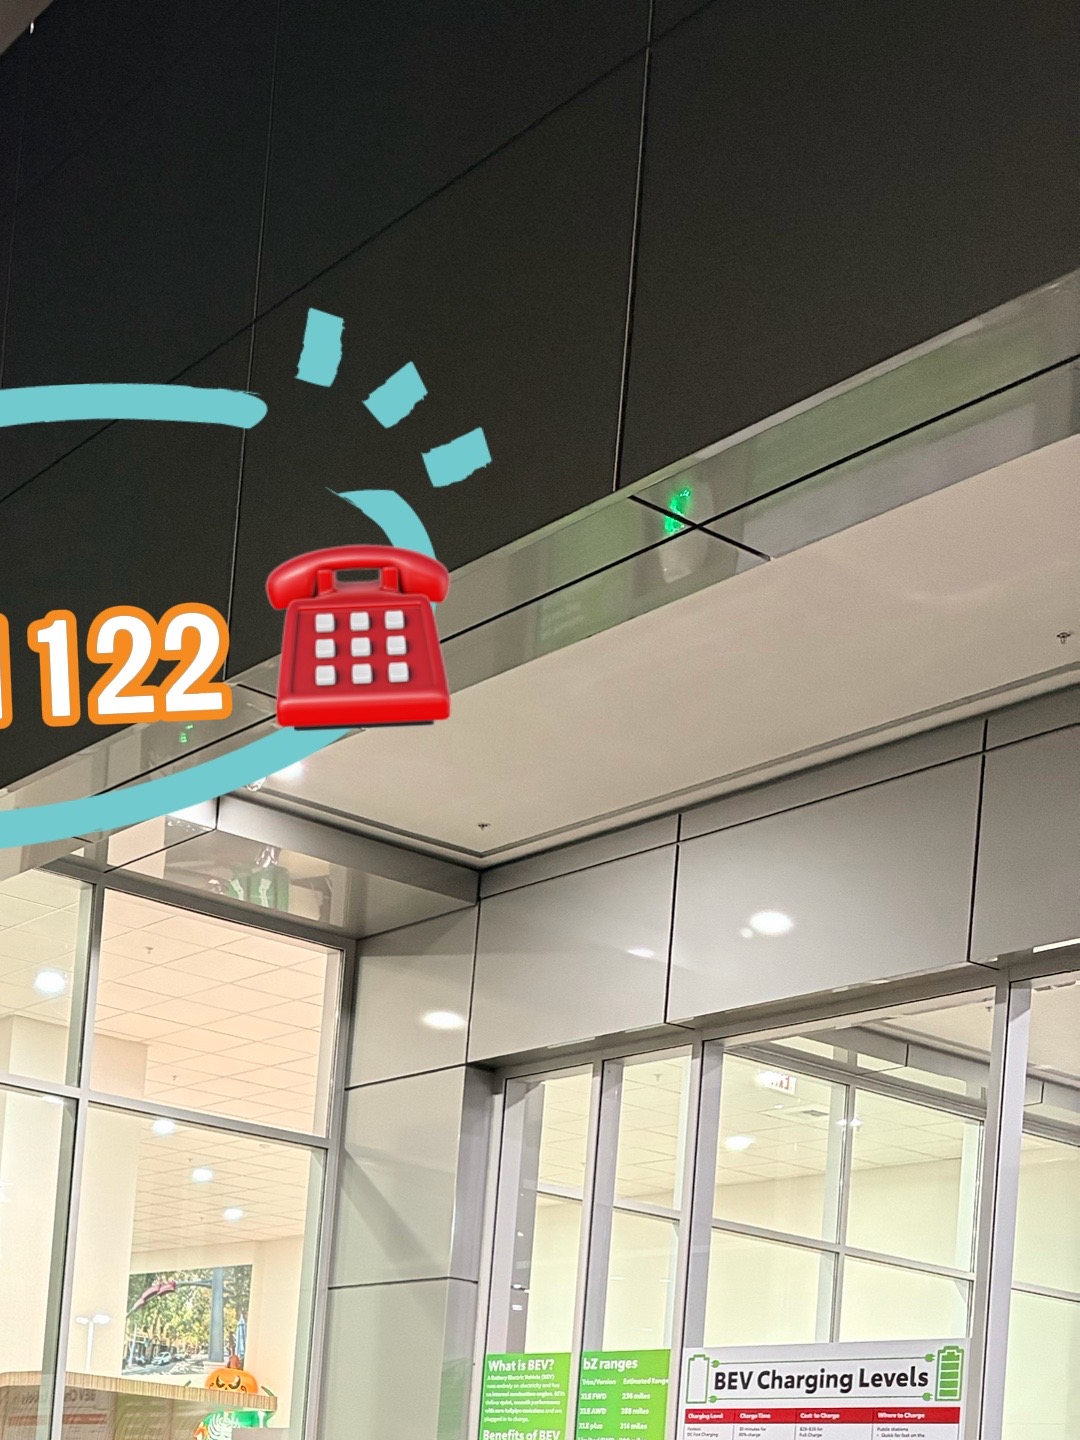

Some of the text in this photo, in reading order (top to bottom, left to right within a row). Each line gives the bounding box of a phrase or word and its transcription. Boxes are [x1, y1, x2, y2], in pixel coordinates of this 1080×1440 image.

[488, 1359, 555, 1371] What is BEV?
[583, 1358, 638, 1373] bZ ranges
[623, 1377, 651, 1385] Estimated
[714, 1365, 929, 1394] BEV Charging Levels
[904, 1412, 925, 1420] Charge
[483, 1429, 524, 1440] Benefits
[526, 1429, 538, 1440] of
